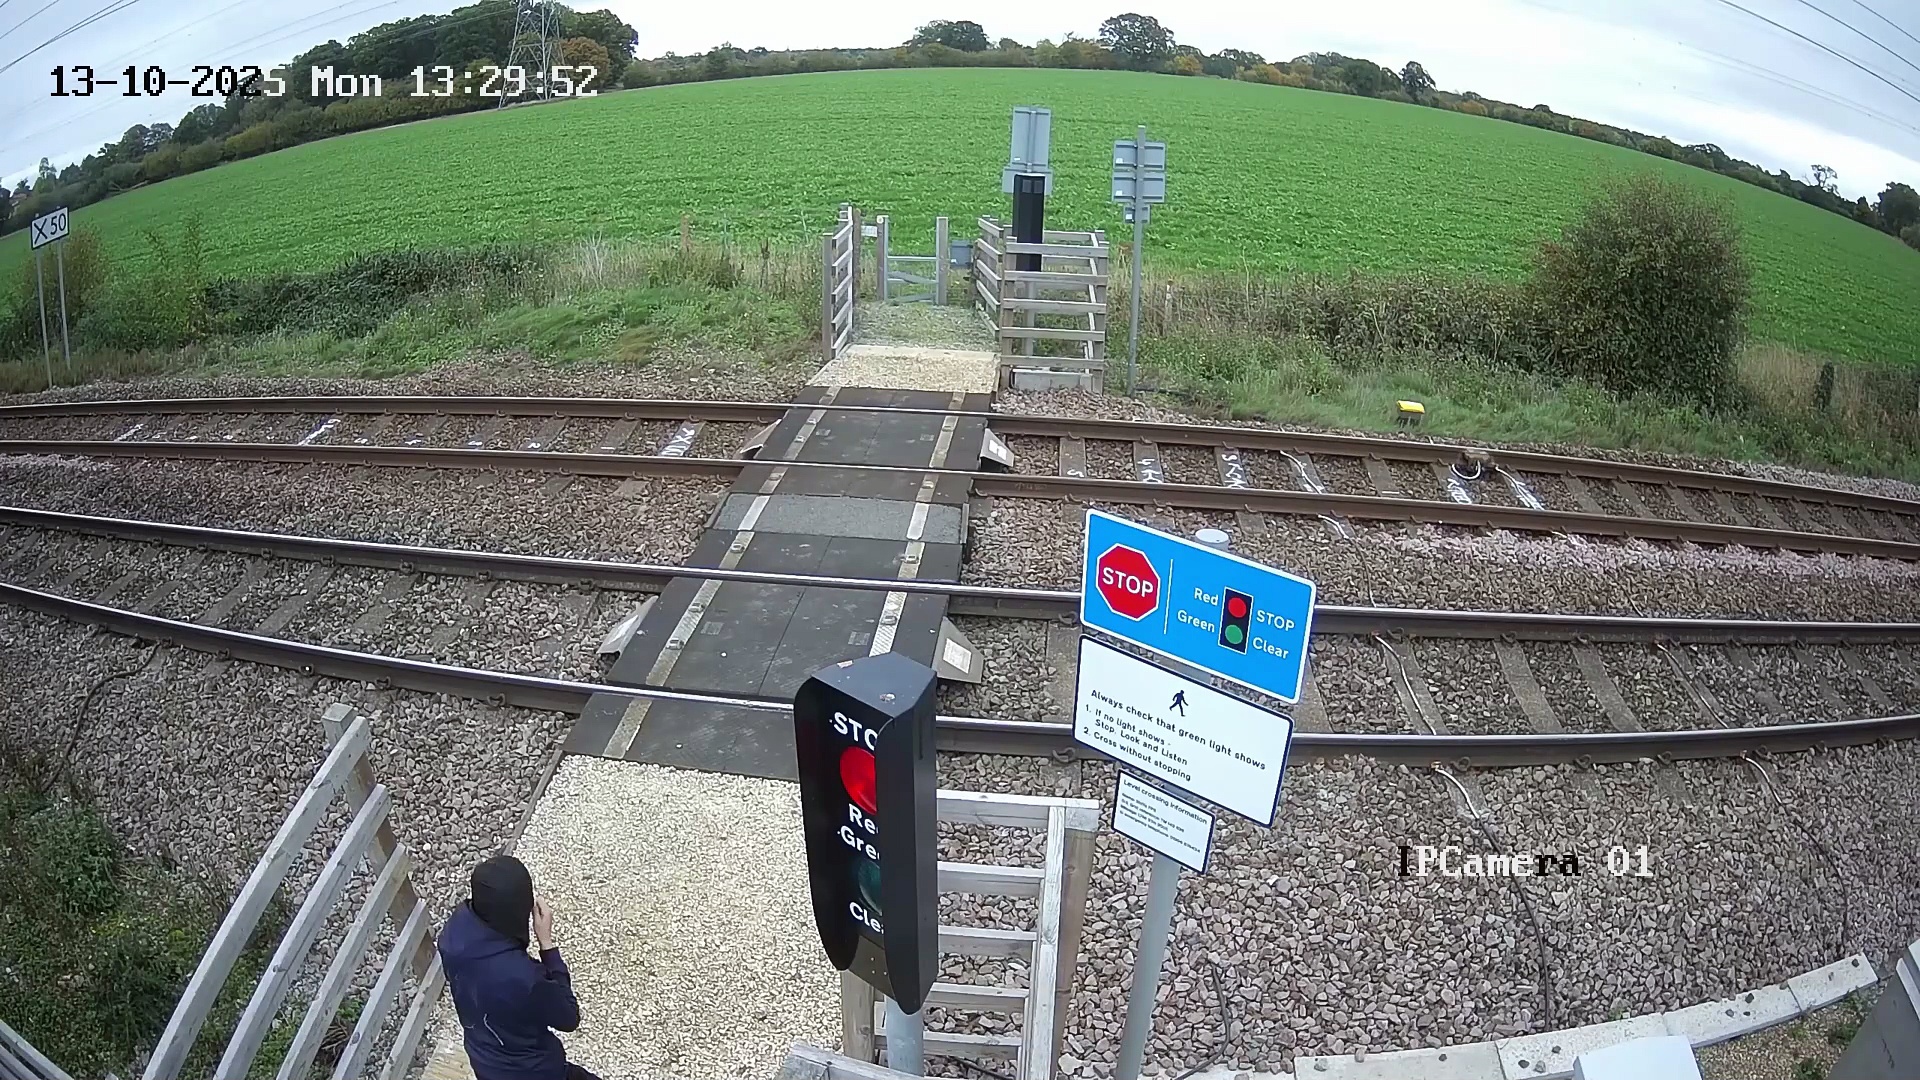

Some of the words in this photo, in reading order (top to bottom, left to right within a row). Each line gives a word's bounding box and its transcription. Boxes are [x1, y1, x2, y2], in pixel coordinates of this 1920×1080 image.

[1102, 567, 1154, 598] STOP
[1194, 587, 1219, 606] Red
[1177, 610, 1216, 633] Green
[1256, 610, 1295, 632] STOP
[1252, 637, 1289, 659] Clear
[833, 711, 879, 751] STO
[1091, 689, 1123, 710] Always
[1126, 705, 1153, 722] check
[1156, 716, 1176, 732] that
[1179, 728, 1206, 745] green
[1209, 739, 1232, 757] light
[1235, 751, 1266, 770] shows
[1095, 708, 1102, 717] If
[1104, 713, 1115, 723] no
[1116, 717, 1136, 733] light
[1138, 728, 1165, 746] shows
[1093, 732, 1117, 748] Cross
[1119, 741, 1152, 763] without
[1154, 759, 1191, 782] stopping
[1120, 729, 1140, 744] Look
[1142, 740, 1159, 753] and
[1161, 747, 1188, 766] Listen
[1124, 779, 1141, 792] Level
[1141, 789, 1169, 807] crossing
[848, 803, 879, 835] Re
[840, 825, 880, 860] Gre
[849, 901, 885, 935] Cle
